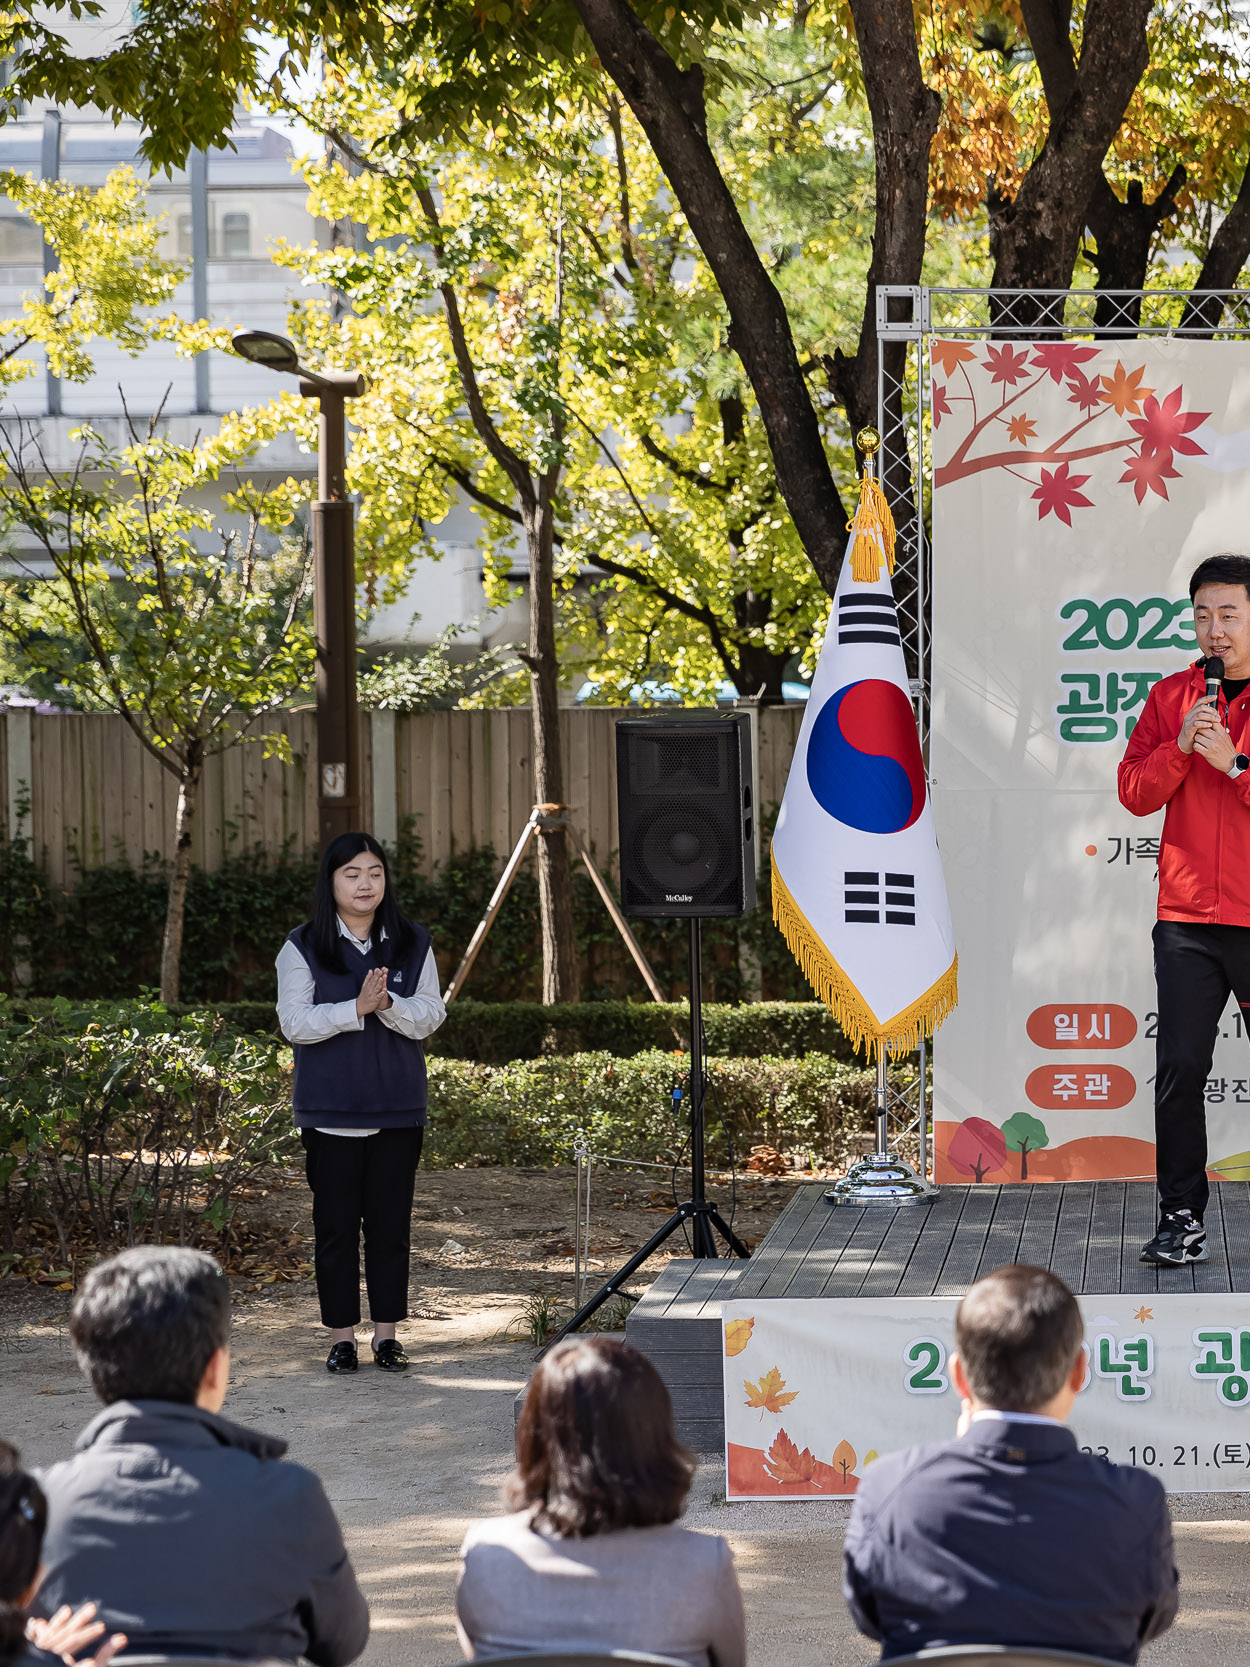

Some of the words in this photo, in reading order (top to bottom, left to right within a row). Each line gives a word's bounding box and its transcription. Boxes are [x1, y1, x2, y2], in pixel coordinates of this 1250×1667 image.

[1060, 597, 1200, 651] 2023
[1053, 1013, 1111, 1040] 일시
[1052, 1074, 1111, 1101] 주관
